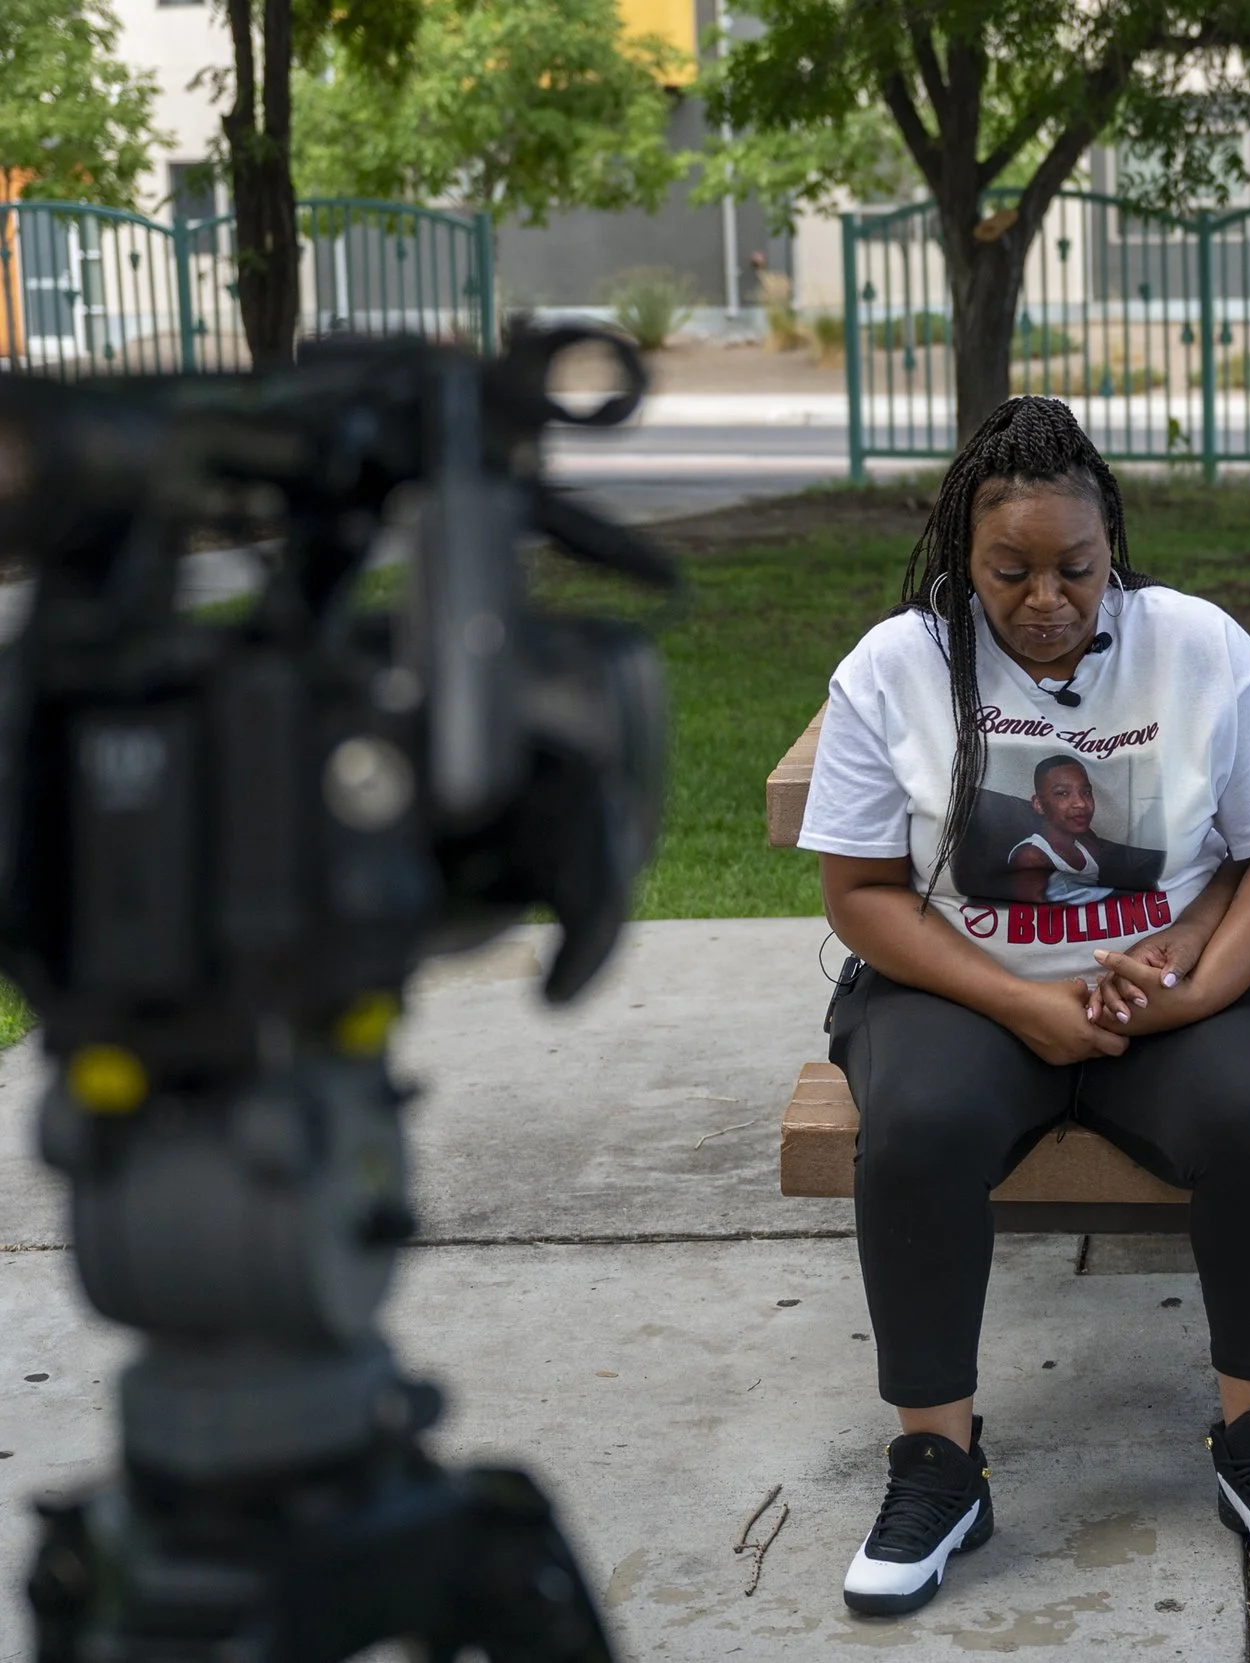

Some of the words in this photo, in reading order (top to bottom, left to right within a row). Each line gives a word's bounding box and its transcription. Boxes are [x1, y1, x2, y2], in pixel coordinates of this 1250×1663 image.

[974, 705, 1054, 737] Bennie
[1056, 722, 1159, 759] Hargrove
[1007, 890, 1172, 945] BULLING
